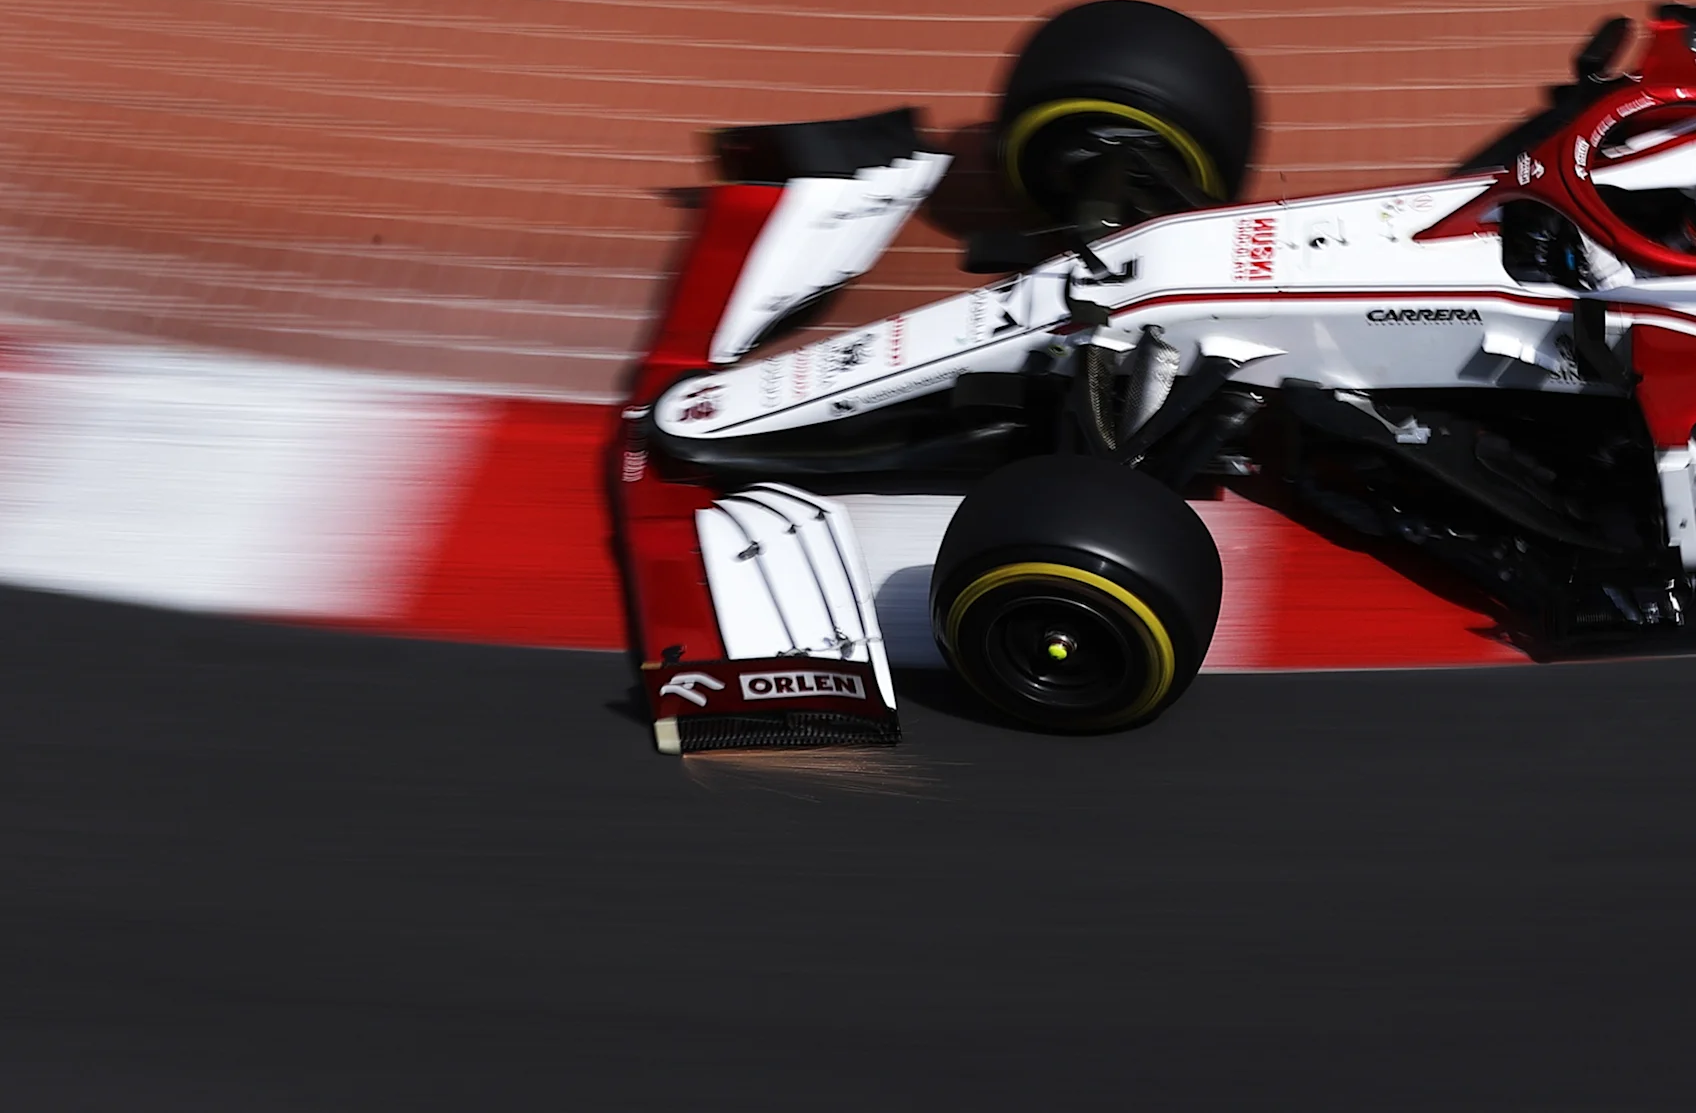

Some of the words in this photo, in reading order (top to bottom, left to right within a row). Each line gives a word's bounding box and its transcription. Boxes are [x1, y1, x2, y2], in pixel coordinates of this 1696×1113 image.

[1249, 218, 1277, 282] HUSKI
[1366, 309, 1483, 322] CARRERA
[748, 674, 857, 696] ORLEN
